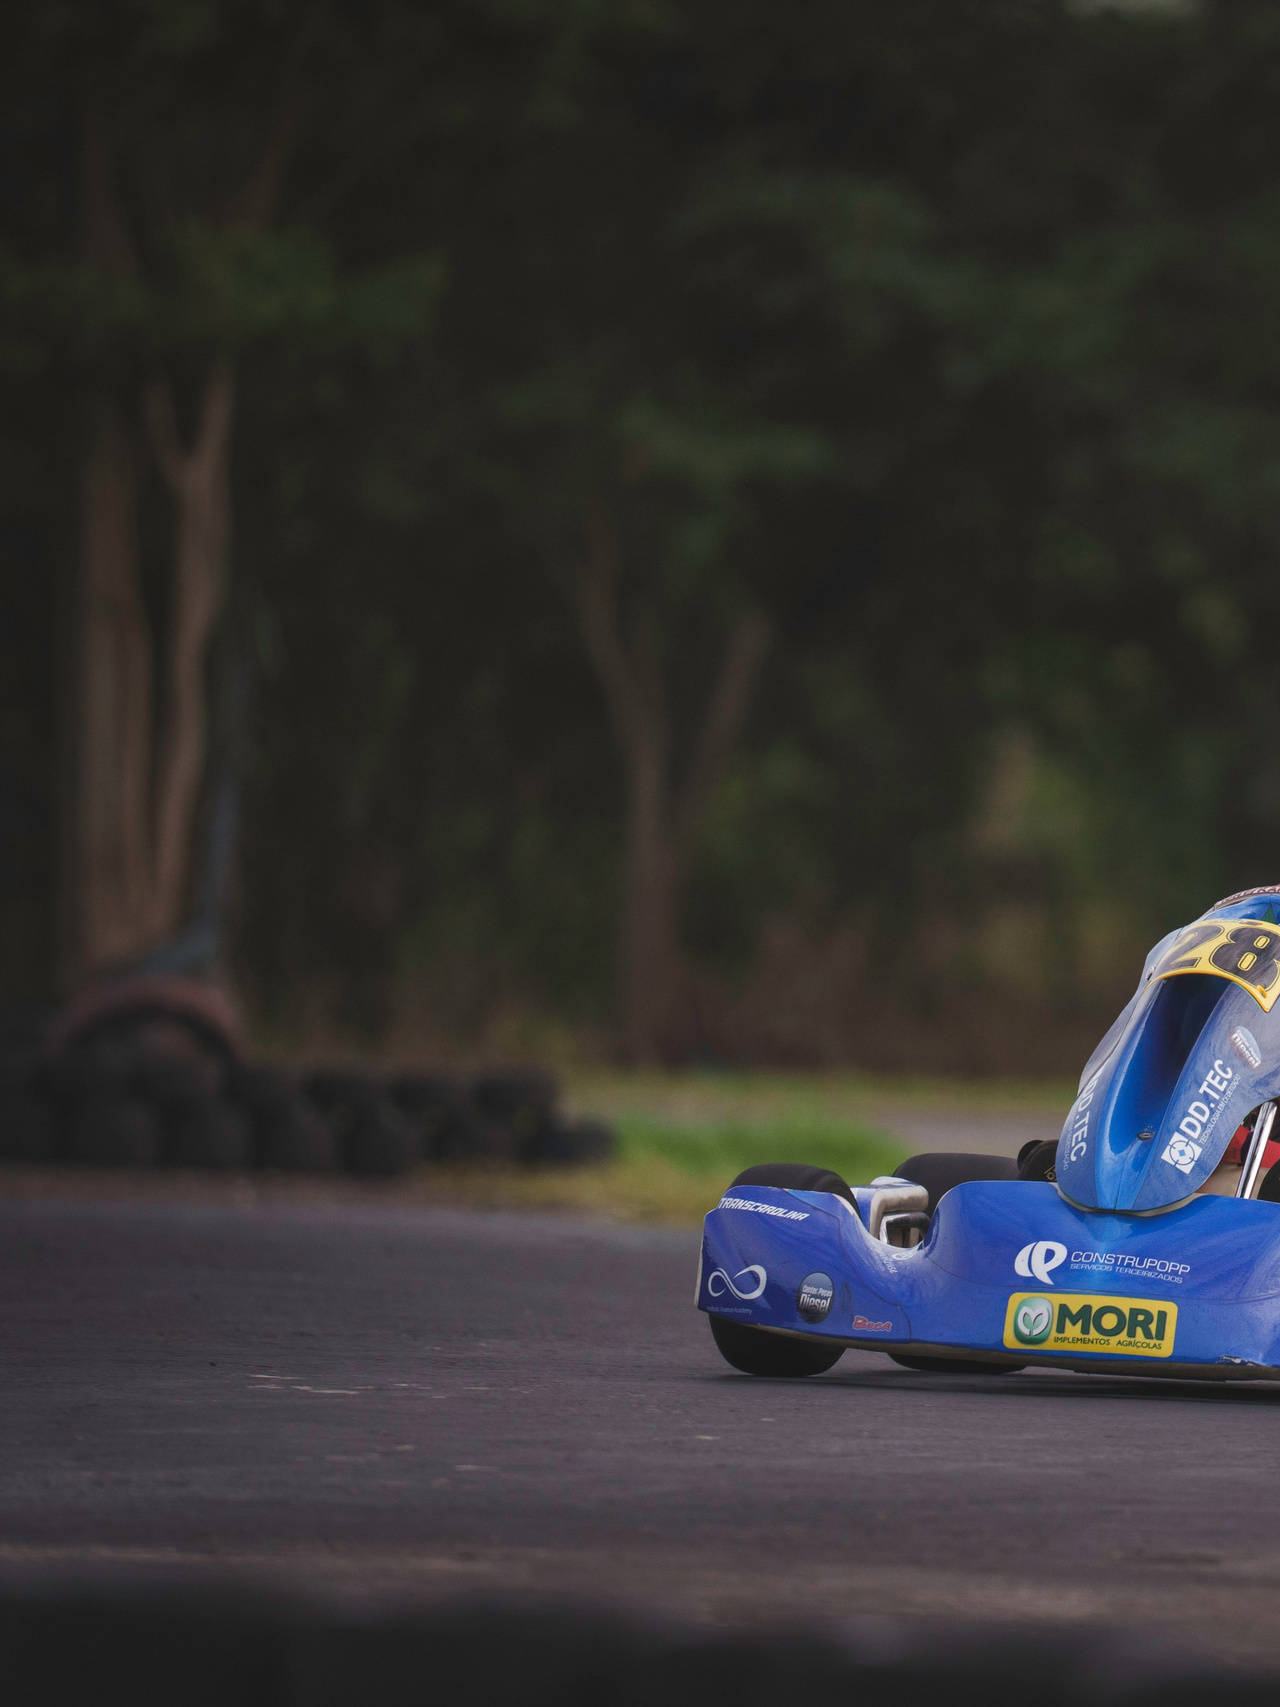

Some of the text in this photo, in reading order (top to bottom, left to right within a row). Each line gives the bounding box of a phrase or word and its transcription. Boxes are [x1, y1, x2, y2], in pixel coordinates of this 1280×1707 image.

[1179, 1059, 1233, 1140] DD.TEC
[1198, 1108, 1222, 1145] TECNOLOGIA
[719, 1197, 810, 1221] TRANSCAROLINA
[1070, 1263, 1183, 1284] SERVIÇOS TERCEIRIZADOS
[1071, 1251, 1191, 1276] CONSTRUPOPP
[802, 1285, 818, 1295] Center
[800, 1293, 831, 1313] Diesel
[1055, 1303, 1168, 1341] MORI
[1054, 1336, 1162, 1350] IMPLEMENTOS AGRÍCOLAS
